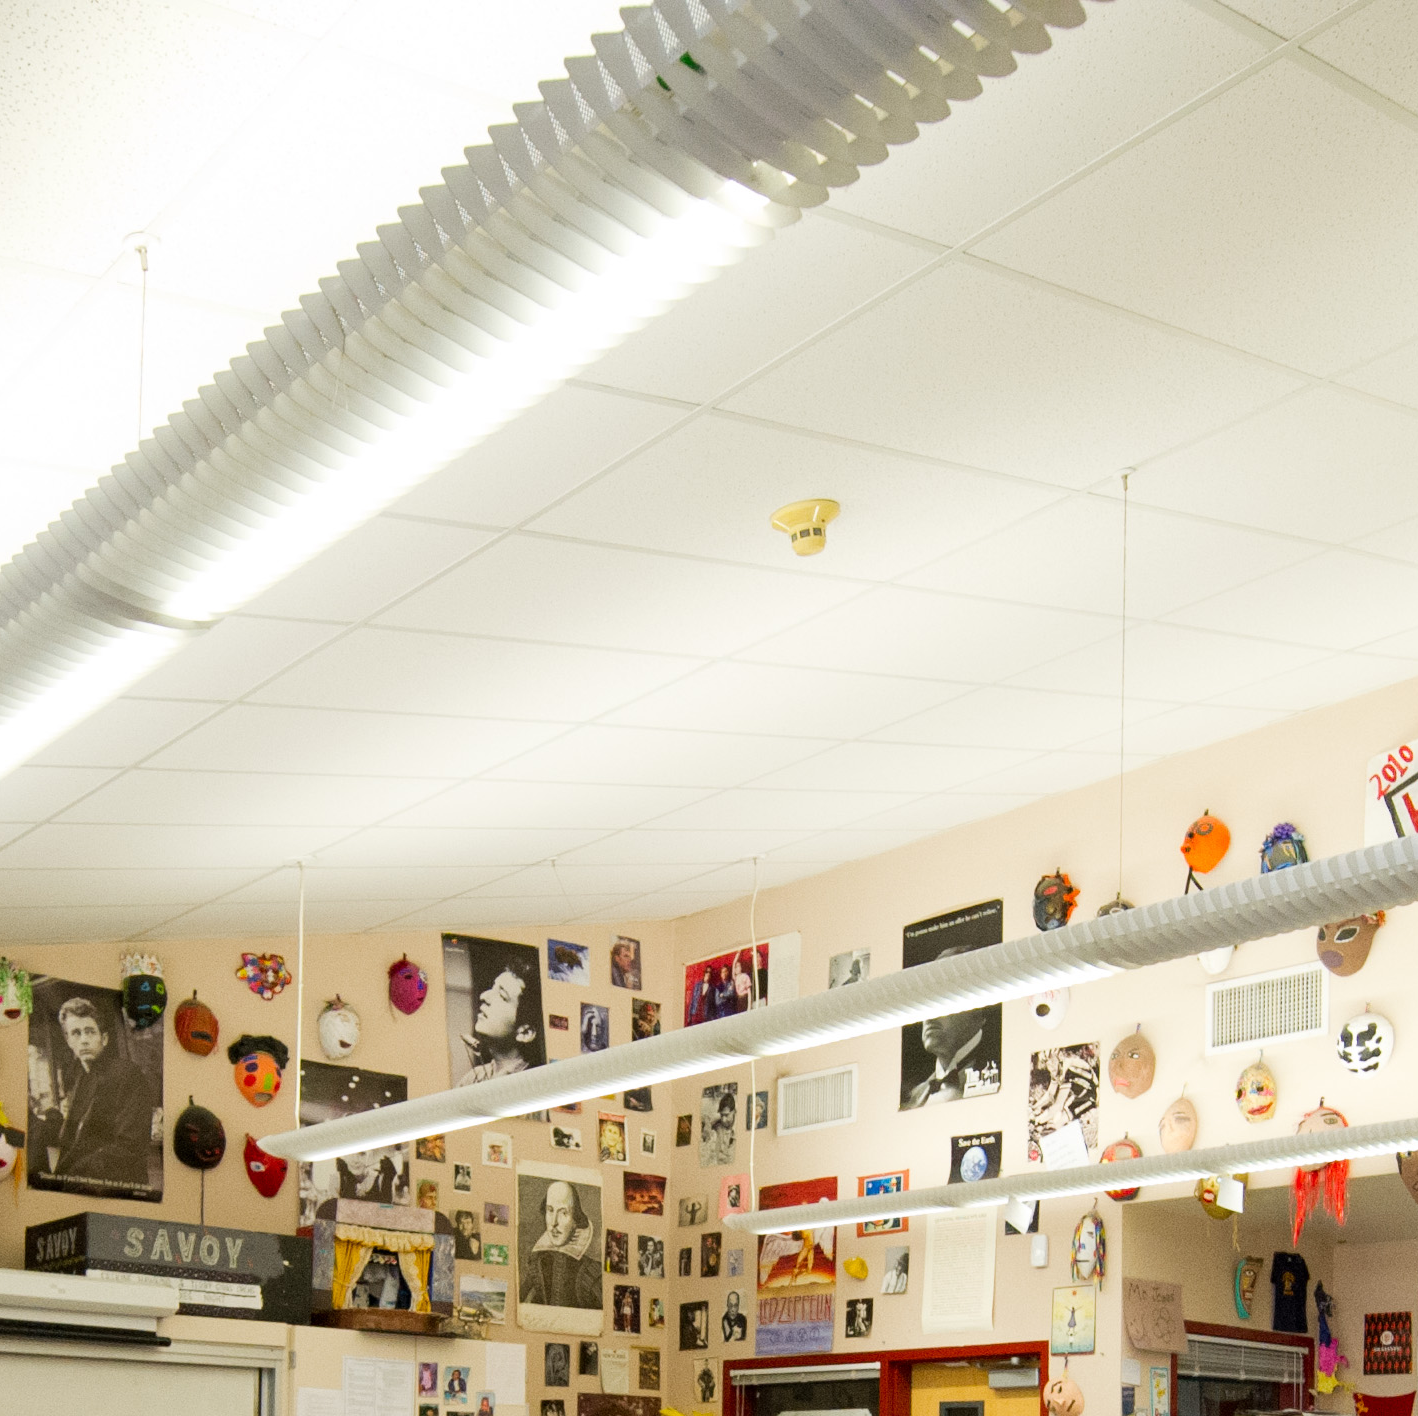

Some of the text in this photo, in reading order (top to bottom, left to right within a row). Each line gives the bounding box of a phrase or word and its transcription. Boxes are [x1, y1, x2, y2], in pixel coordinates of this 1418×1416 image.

[1368, 744, 1415, 800] 2010
[36, 1227, 78, 1263] SAVOY
[123, 1226, 245, 1269] SAVOY
